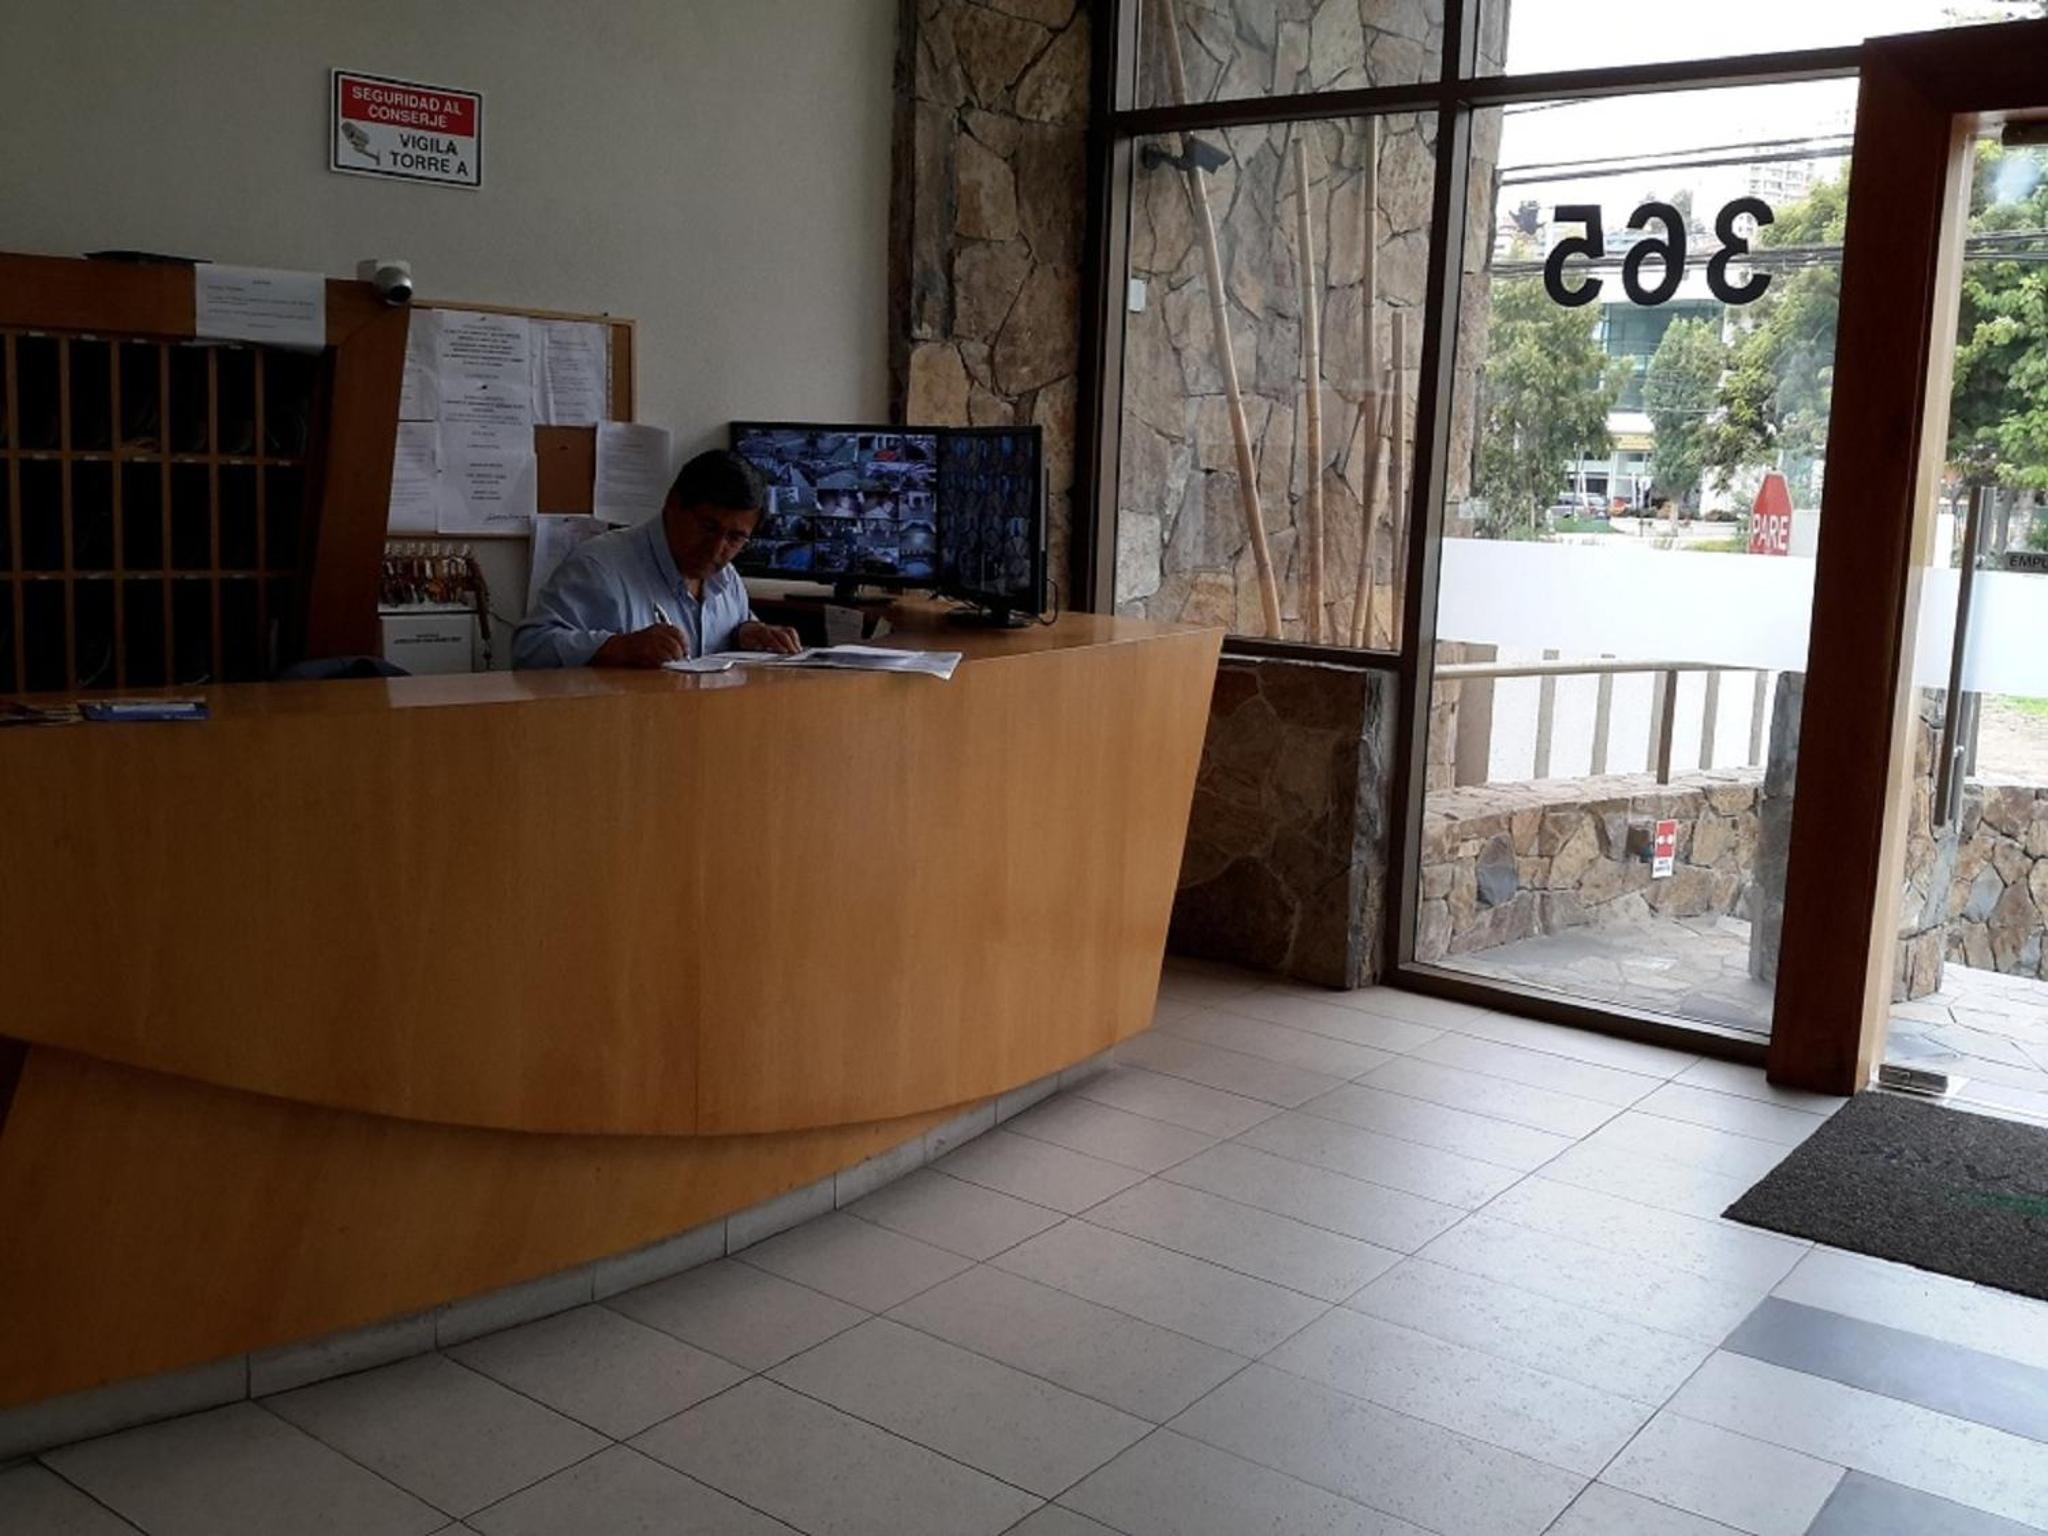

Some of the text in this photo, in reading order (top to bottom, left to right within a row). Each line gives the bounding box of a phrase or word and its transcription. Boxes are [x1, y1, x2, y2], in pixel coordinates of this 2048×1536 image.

[352, 86, 462, 116] SEGURIDAD AL
[368, 105, 448, 127] CONSERJE
[400, 134, 457, 155] VIGILA
[390, 152, 468, 177] TORRE A
[1749, 513, 1789, 550] PARE
